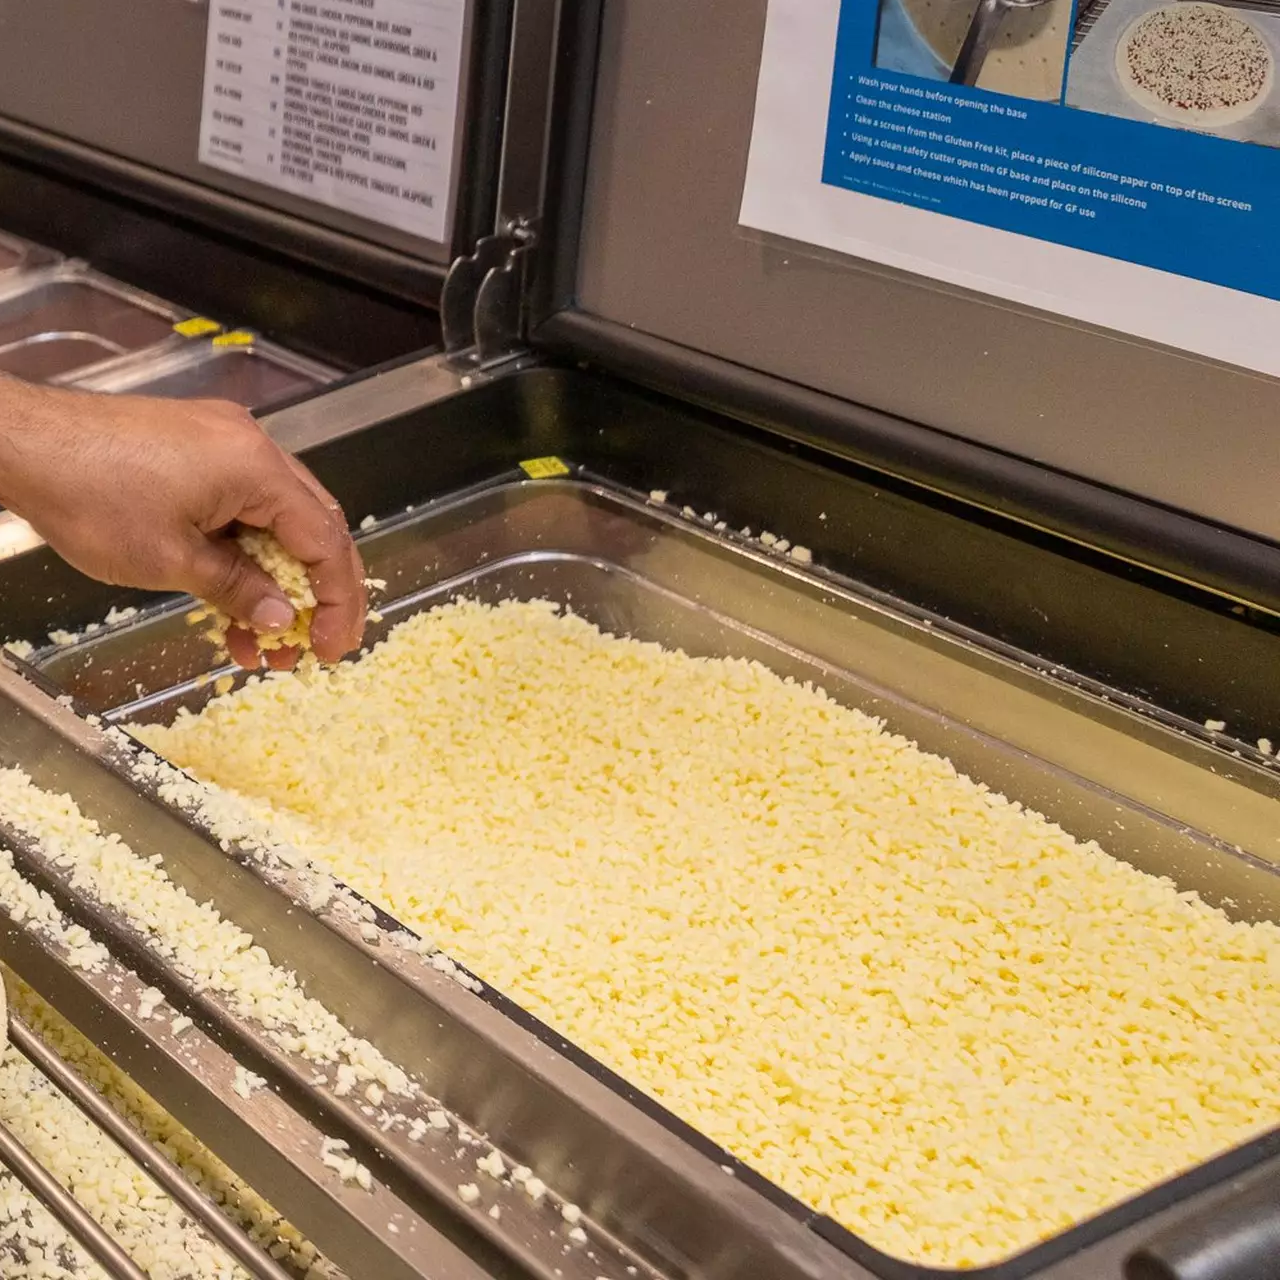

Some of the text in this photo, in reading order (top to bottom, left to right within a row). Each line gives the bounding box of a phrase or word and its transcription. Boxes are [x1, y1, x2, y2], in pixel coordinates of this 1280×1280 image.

[856, 94, 951, 123] Clean the cheese station
[858, 75, 1027, 119] Wash your hands before opening the base
[850, 151, 1095, 218] Apply sauce and cheese which has been prepped for GF use
[852, 133, 872, 147] Using
[880, 140, 902, 152] clean
[903, 145, 928, 159] safety
[930, 152, 955, 164] cutter
[957, 158, 978, 171] open
[980, 163, 994, 174] the
[997, 167, 1008, 176] GF
[1009, 169, 1031, 182] base
[1032, 176, 1050, 187] and
[1052, 179, 1076, 193] place
[1078, 186, 1090, 195] on
[1092, 189, 1108, 200] the
[1111, 193, 1147, 209] silicone
[854, 114, 872, 125] Take
[880, 121, 905, 133] screen
[907, 126, 927, 138] from
[929, 130, 943, 141] the
[944, 135, 973, 148] Gluten
[975, 141, 993, 153] Free
[994, 146, 1009, 158] kit,
[1011, 150, 1035, 164] place
[1044, 158, 1069, 172] piece
[1071, 163, 1082, 172] of
[1083, 166, 1119, 182] silicone
[1120, 175, 1148, 189] paper
[1150, 181, 1164, 191] on
[1165, 184, 1183, 197] top
[1185, 188, 1196, 198] of
[1197, 191, 1215, 203] the
[1217, 197, 1252, 211] screen
